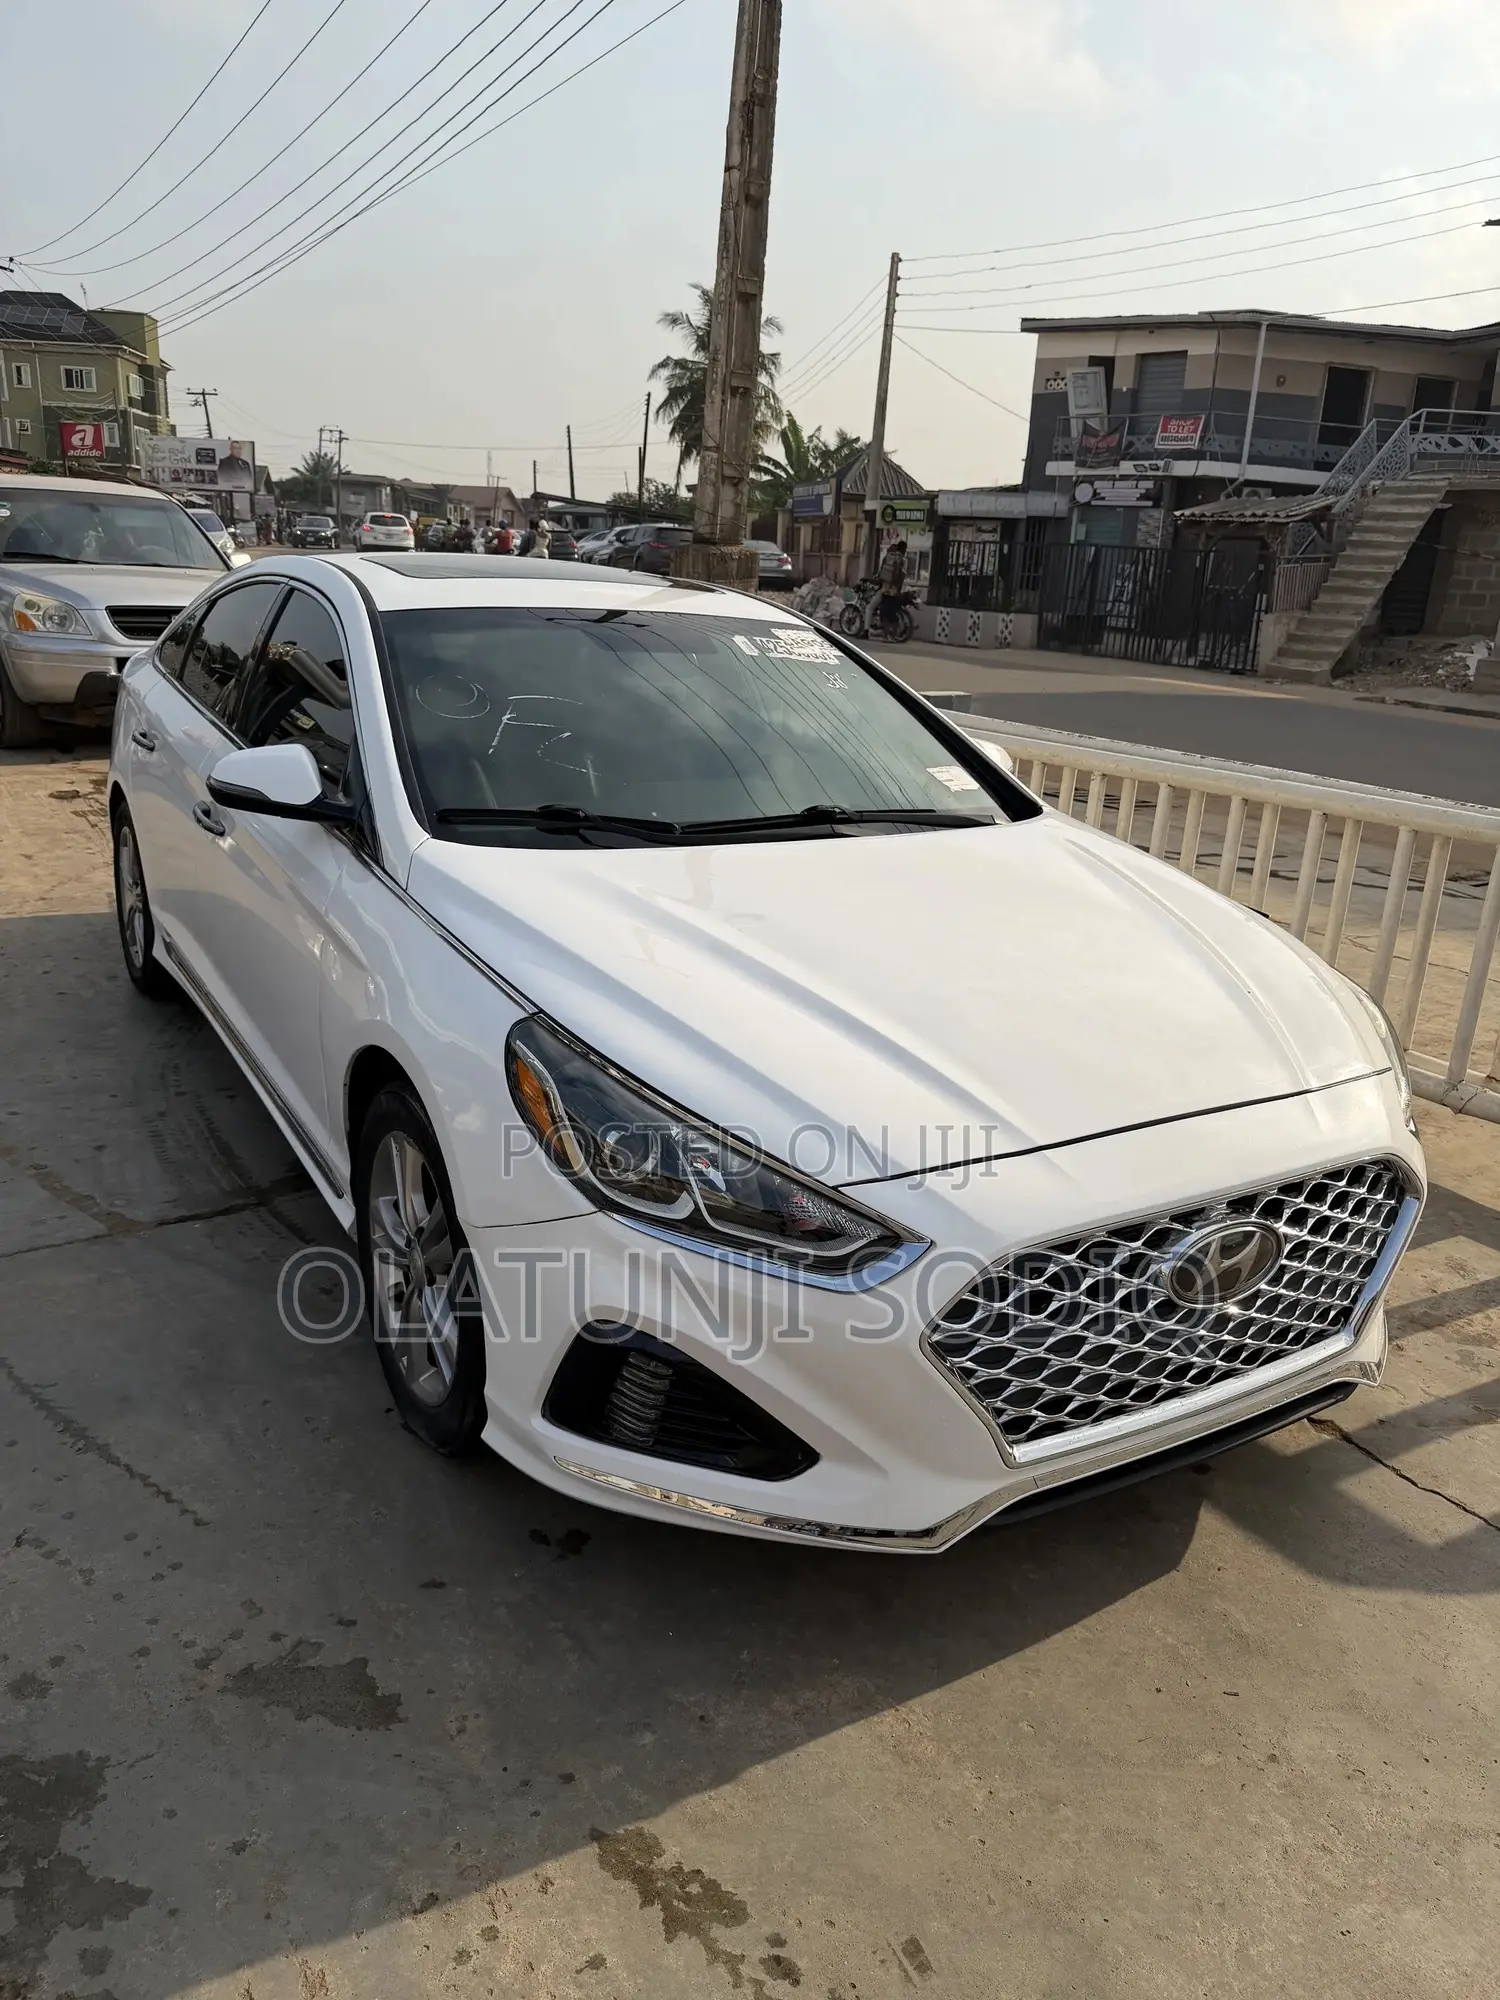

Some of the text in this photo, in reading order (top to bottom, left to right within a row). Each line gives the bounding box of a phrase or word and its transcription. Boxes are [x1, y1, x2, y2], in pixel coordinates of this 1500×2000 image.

[1167, 425, 1196, 433] TO LET
[67, 449, 102, 457] addide
